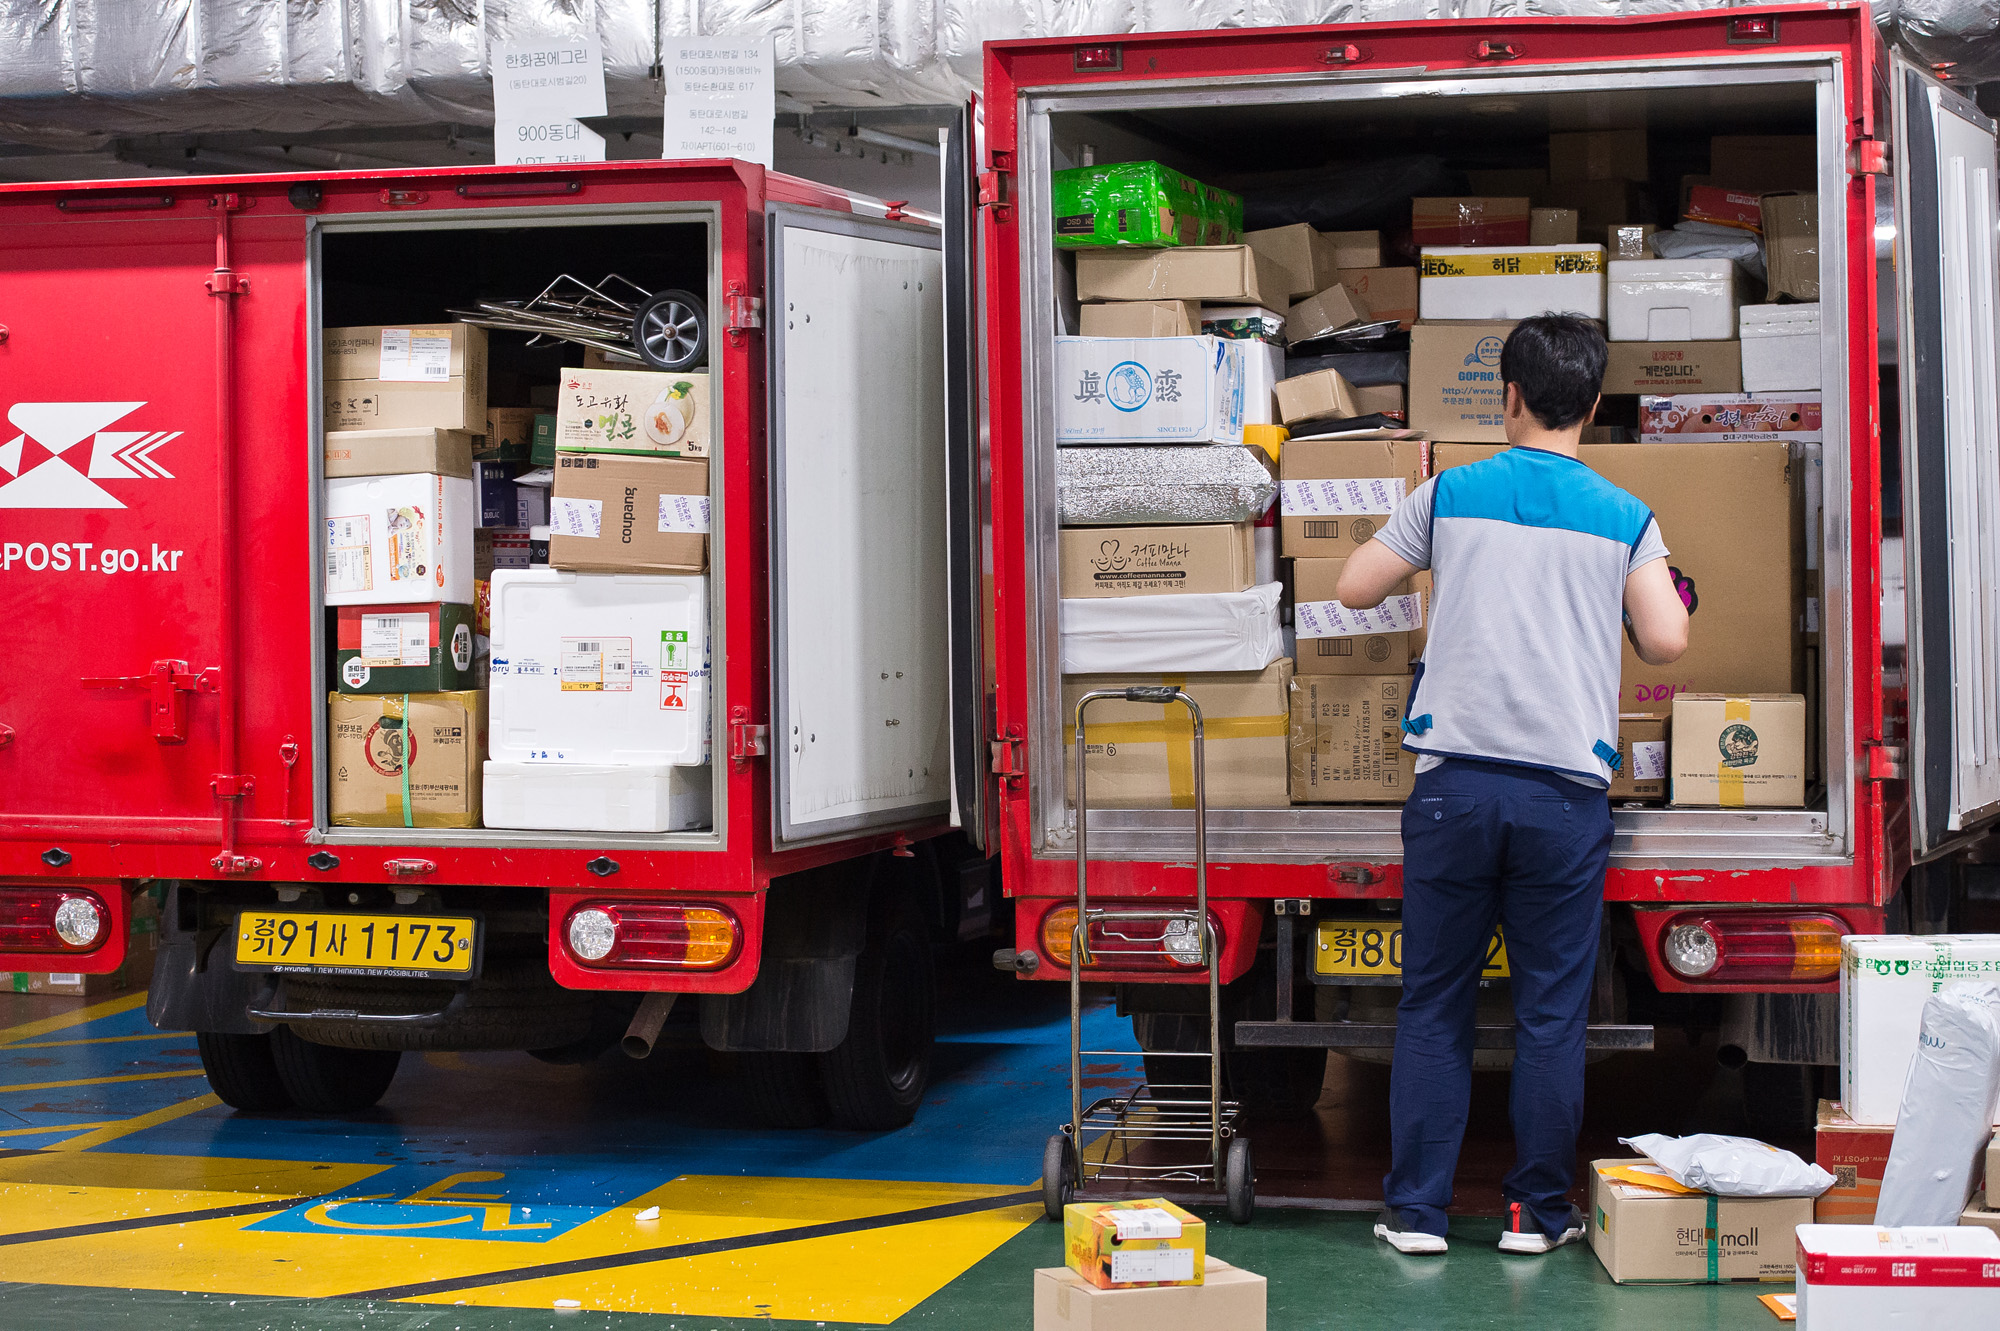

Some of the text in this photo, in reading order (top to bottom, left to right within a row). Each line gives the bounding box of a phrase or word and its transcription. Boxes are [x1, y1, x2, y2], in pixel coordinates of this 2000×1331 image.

[504, 49, 588, 69] 한화꿈에그린
[680, 49, 759, 60] 동탄대로시범길 134
[509, 76, 587, 91] (동탄대로시범길20)
[739, 82, 755, 92] 617
[689, 109, 749, 120] 동탄대로시범길
[518, 124, 581, 143] 900동대
[1491, 257, 1521, 273] 허닭
[1458, 371, 1494, 382] GOPRO
[688, 441, 703, 452] 5kg
[622, 486, 638, 544] coupang
[1131, 541, 1190, 559] 커피만나
[0, 543, 183, 574] POST.go.kr
[1136, 557, 1182, 568] Coffee Manna
[1099, 571, 1182, 580] www.coffeemanna.com
[1322, 703, 1330, 717] PCS
[1332, 703, 1340, 717] KGS
[1342, 703, 1350, 717] KGS
[1373, 738, 1381, 755] Black
[278, 919, 348, 958] 91사
[361, 922, 456, 963] 1173
[1675, 1227, 1704, 1246] 현대
[1721, 1227, 1759, 1247] mall
